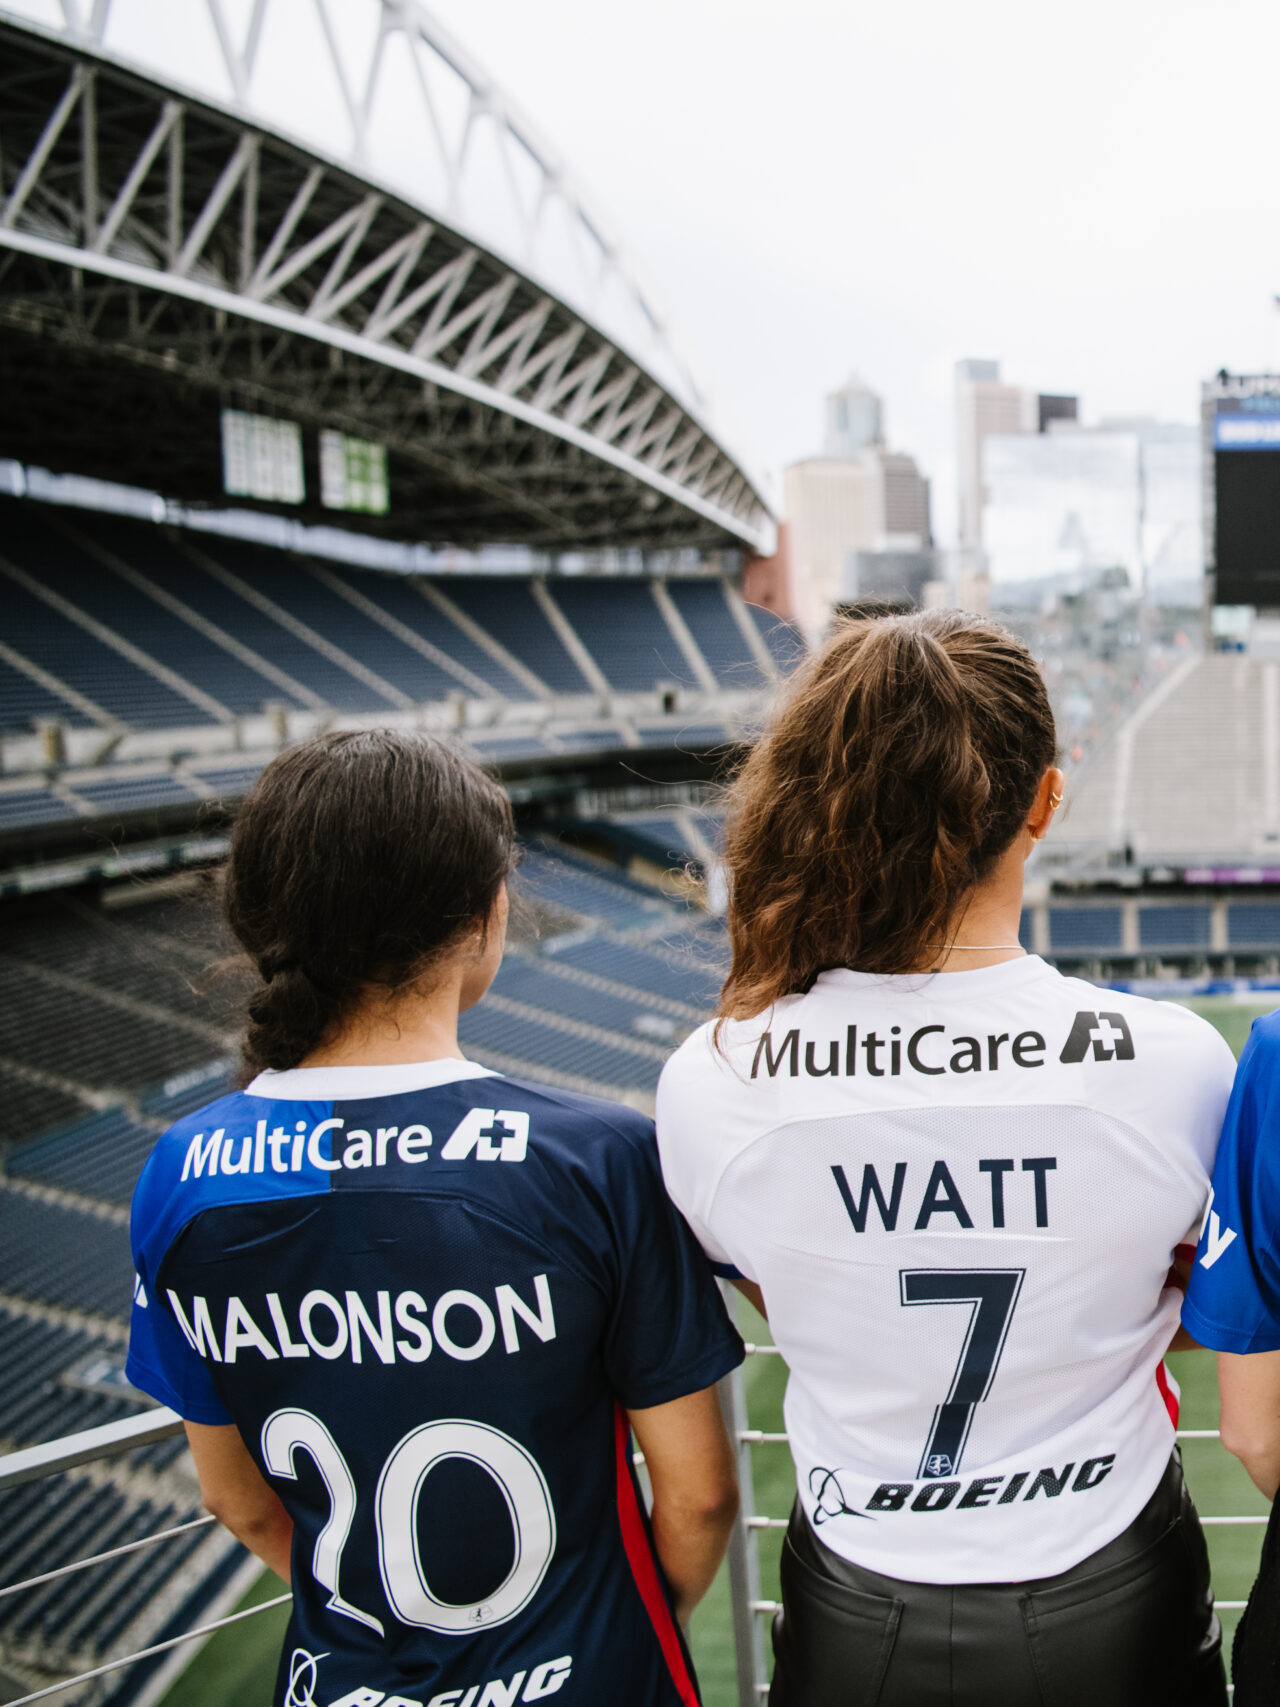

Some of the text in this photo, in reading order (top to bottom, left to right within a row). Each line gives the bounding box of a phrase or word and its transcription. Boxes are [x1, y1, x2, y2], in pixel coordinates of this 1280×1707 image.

[751, 1024, 1046, 1079] MultiCare
[180, 1118, 433, 1182] MultiCare
[830, 1157, 1058, 1232] WATT
[165, 1273, 558, 1364] MALONSON
[899, 1268, 1026, 1479] 7
[865, 1453, 1116, 1512] BOEING
[261, 1407, 557, 1638] 20
